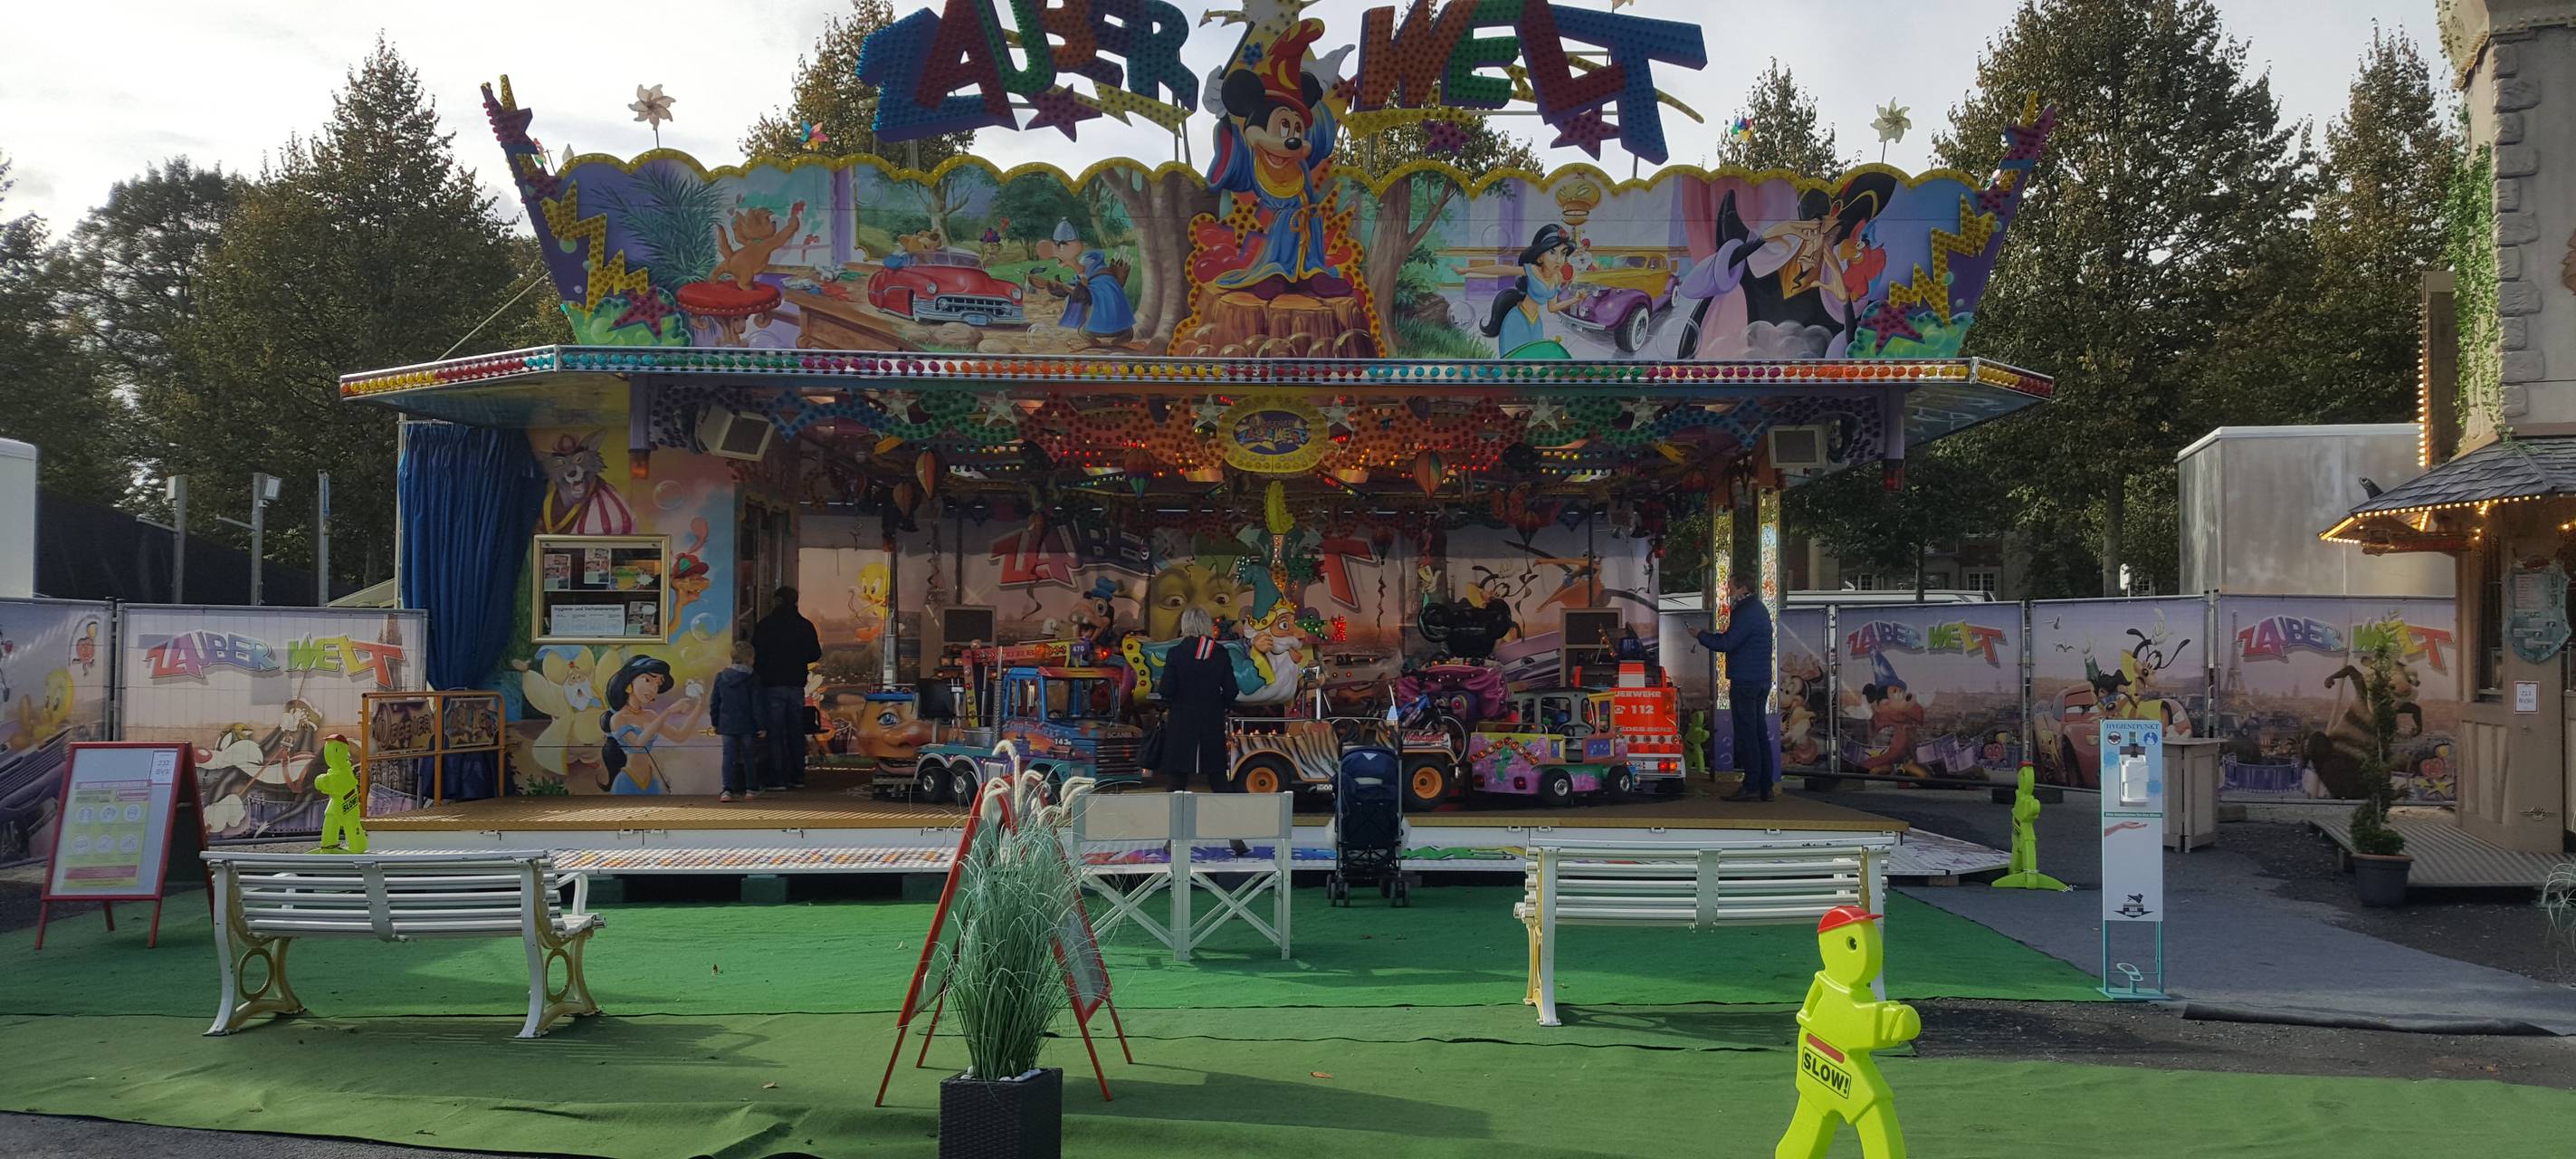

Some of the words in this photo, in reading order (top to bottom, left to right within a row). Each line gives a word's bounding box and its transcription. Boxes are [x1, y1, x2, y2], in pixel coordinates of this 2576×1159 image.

[1352, 0, 1709, 165] WELT
[143, 629, 280, 678] ZAUBER
[285, 633, 405, 688] WELT
[1846, 620, 1924, 656] ZAUBER
[1927, 619, 2006, 667] WELT
[2237, 616, 2348, 662] ZAUBER
[1631, 704, 1655, 714] 112
[1803, 1052, 1849, 1095] SLOW!
